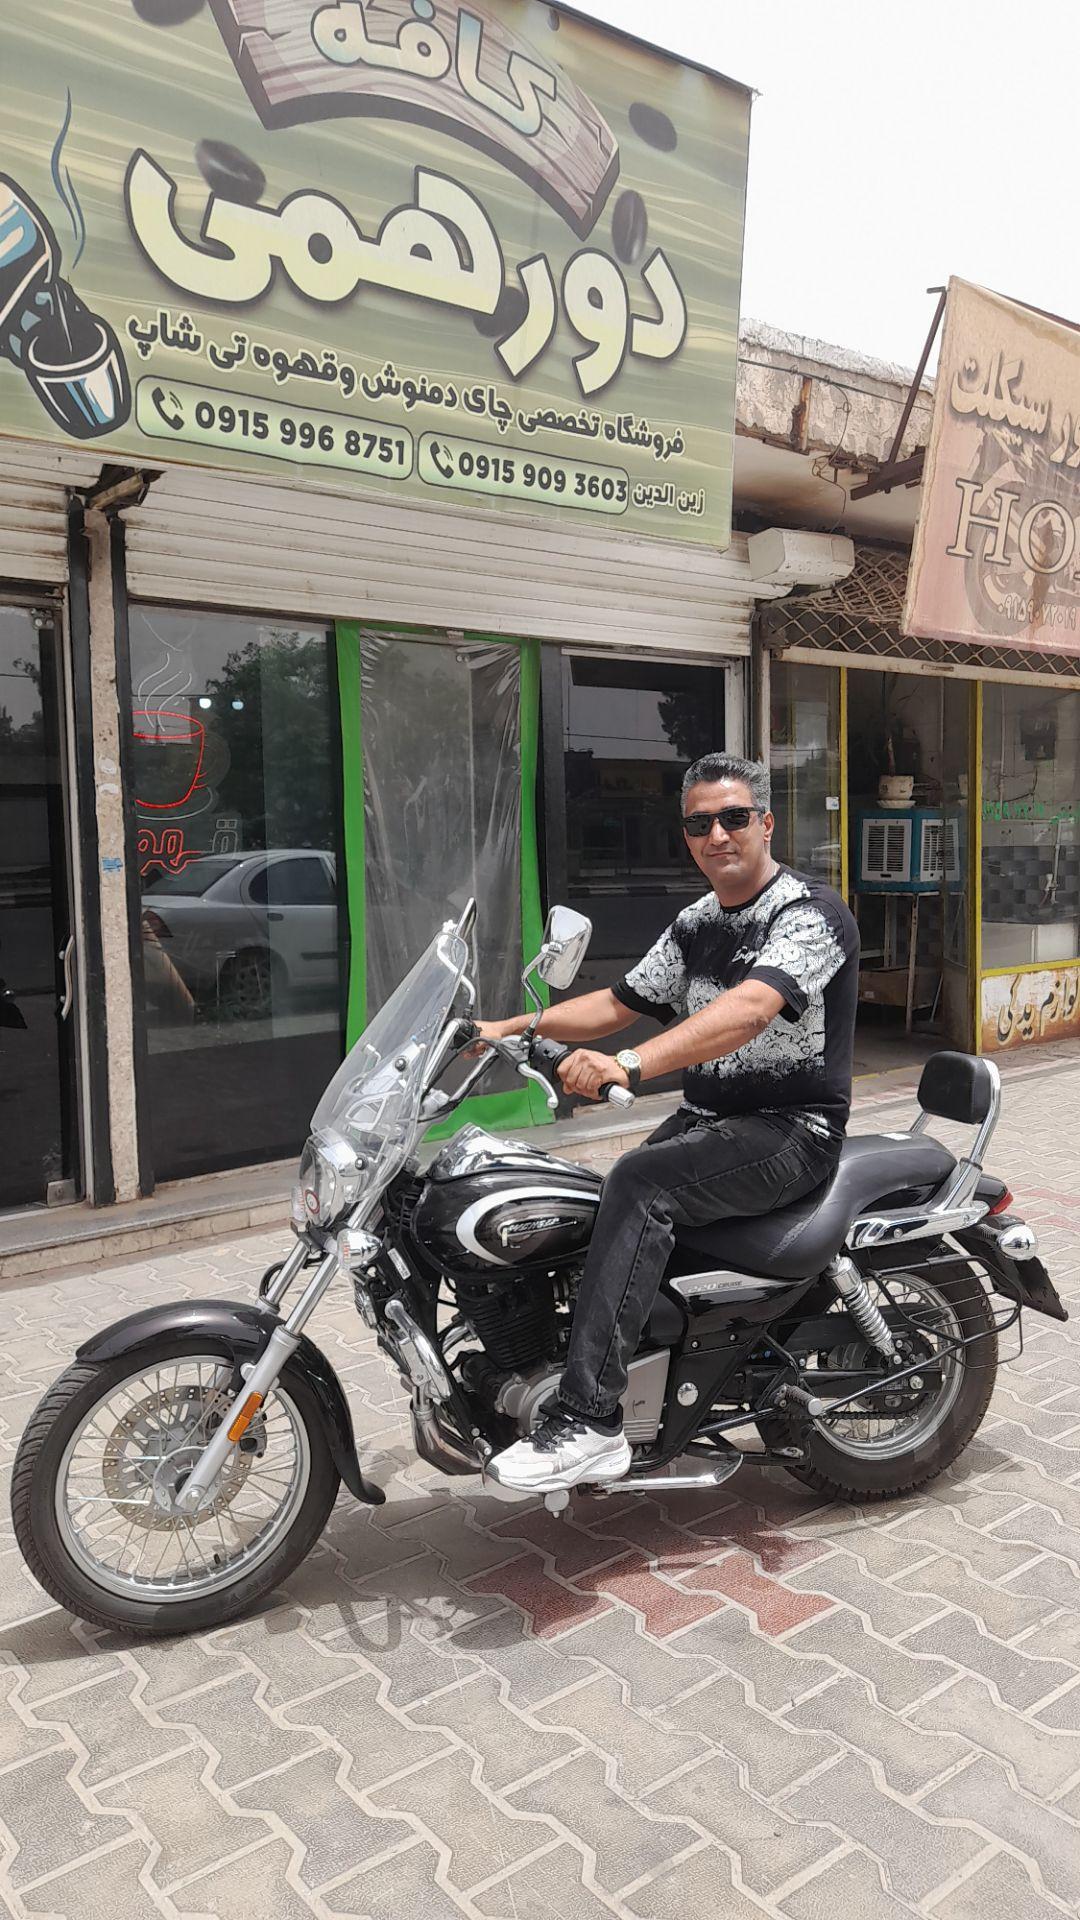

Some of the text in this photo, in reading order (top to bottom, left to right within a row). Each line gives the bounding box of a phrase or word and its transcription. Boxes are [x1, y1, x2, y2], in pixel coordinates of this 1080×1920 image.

[311, 0, 557, 137] کافه
[127, 309, 203, 359] شاپ
[208, 334, 249, 371] تی
[361, 362, 459, 411] دمنوش
[462, 384, 513, 434] چای
[195, 400, 406, 465] 0915 996 8751
[517, 406, 601, 441] تخصصی
[603, 413, 685, 462] فروشگاه
[457, 451, 628, 503] 0915 909 3603
[632, 482, 706, 515] زین الدین
